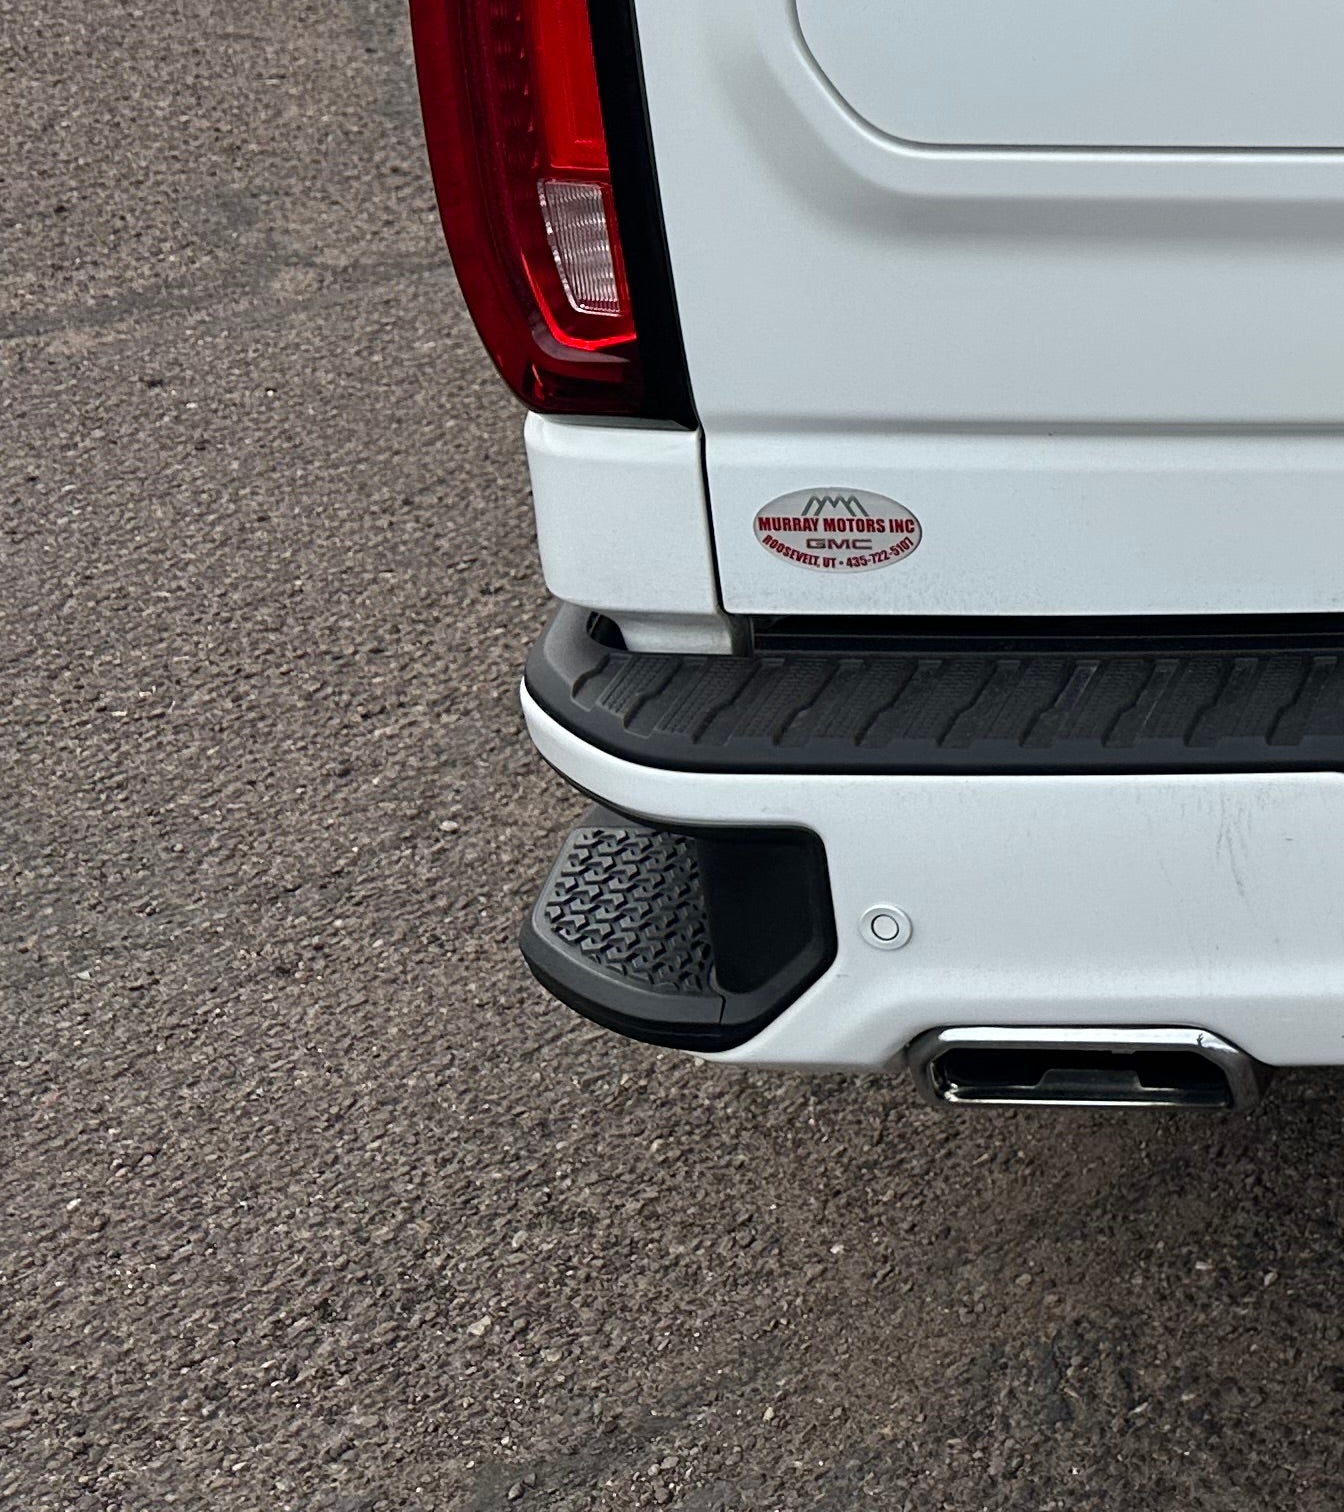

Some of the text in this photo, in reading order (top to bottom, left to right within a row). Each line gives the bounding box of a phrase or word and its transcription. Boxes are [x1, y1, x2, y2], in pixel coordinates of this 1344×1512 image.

[758, 516, 915, 533] MURRAY MOTORS INC
[806, 538, 872, 550] GMC
[822, 557, 836, 568] UT
[846, 536, 914, 568] 435-722-5107
